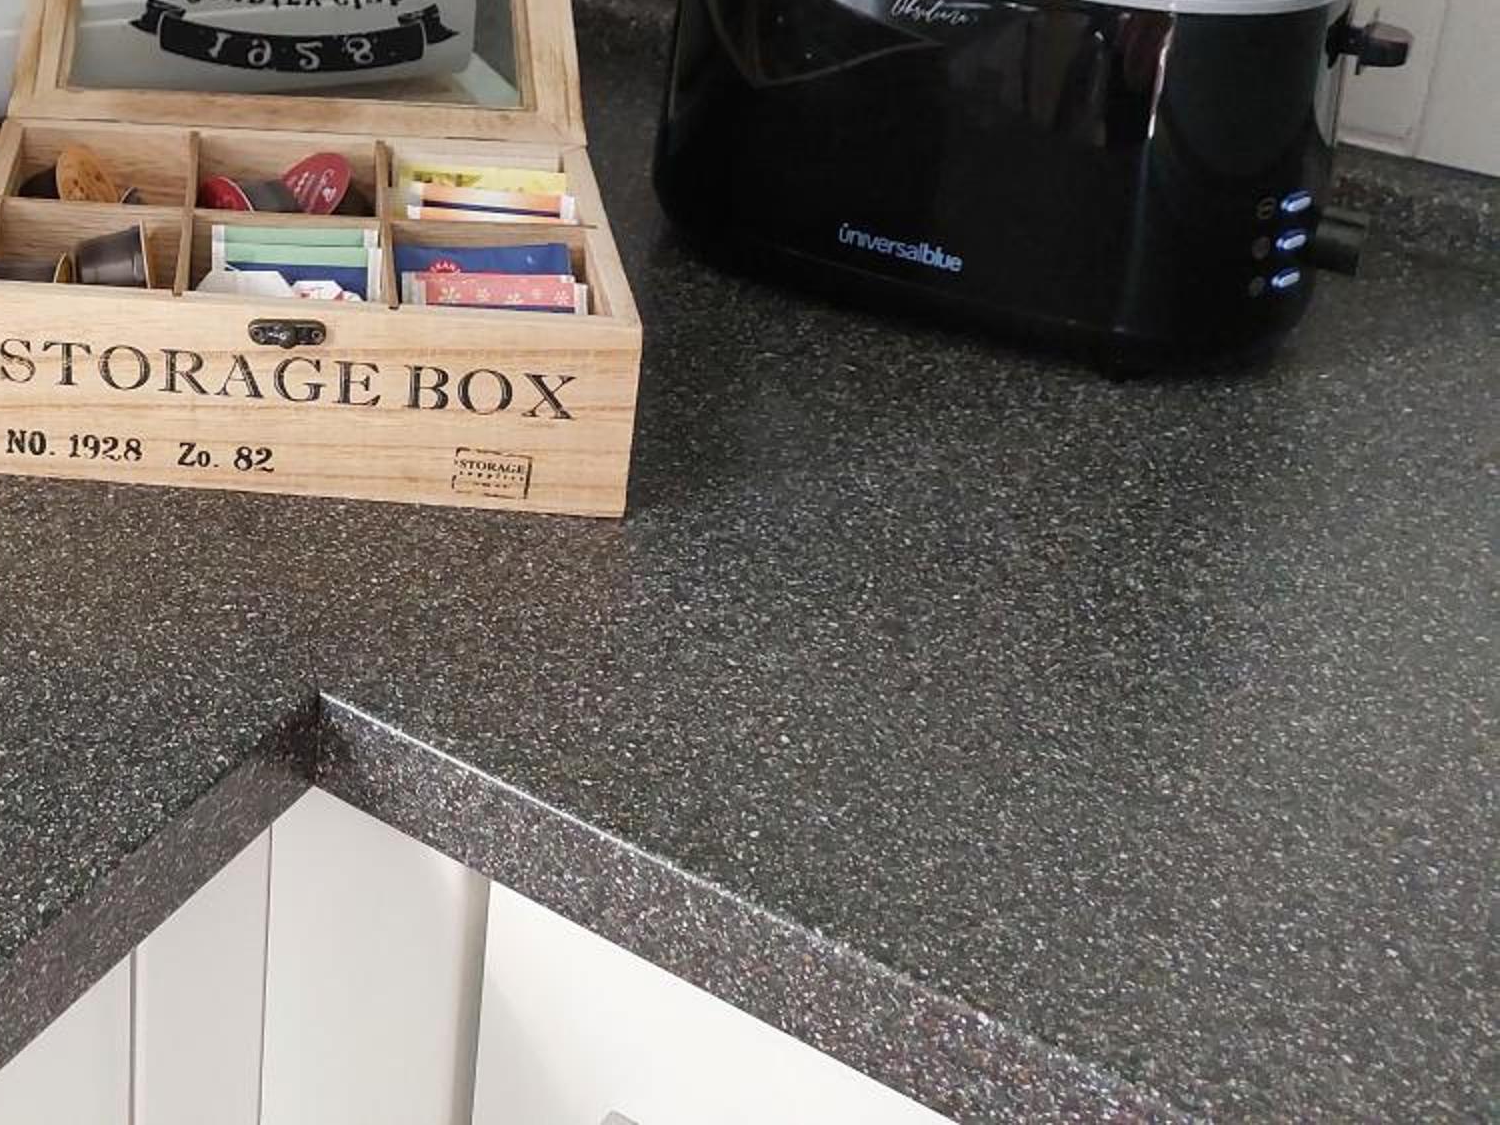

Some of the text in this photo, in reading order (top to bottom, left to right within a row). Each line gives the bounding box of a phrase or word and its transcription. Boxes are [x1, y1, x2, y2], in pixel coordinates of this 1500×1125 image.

[0, 338, 577, 420] STORAGE BOX
[69, 434, 143, 462] 1928
[233, 446, 275, 472] 82
